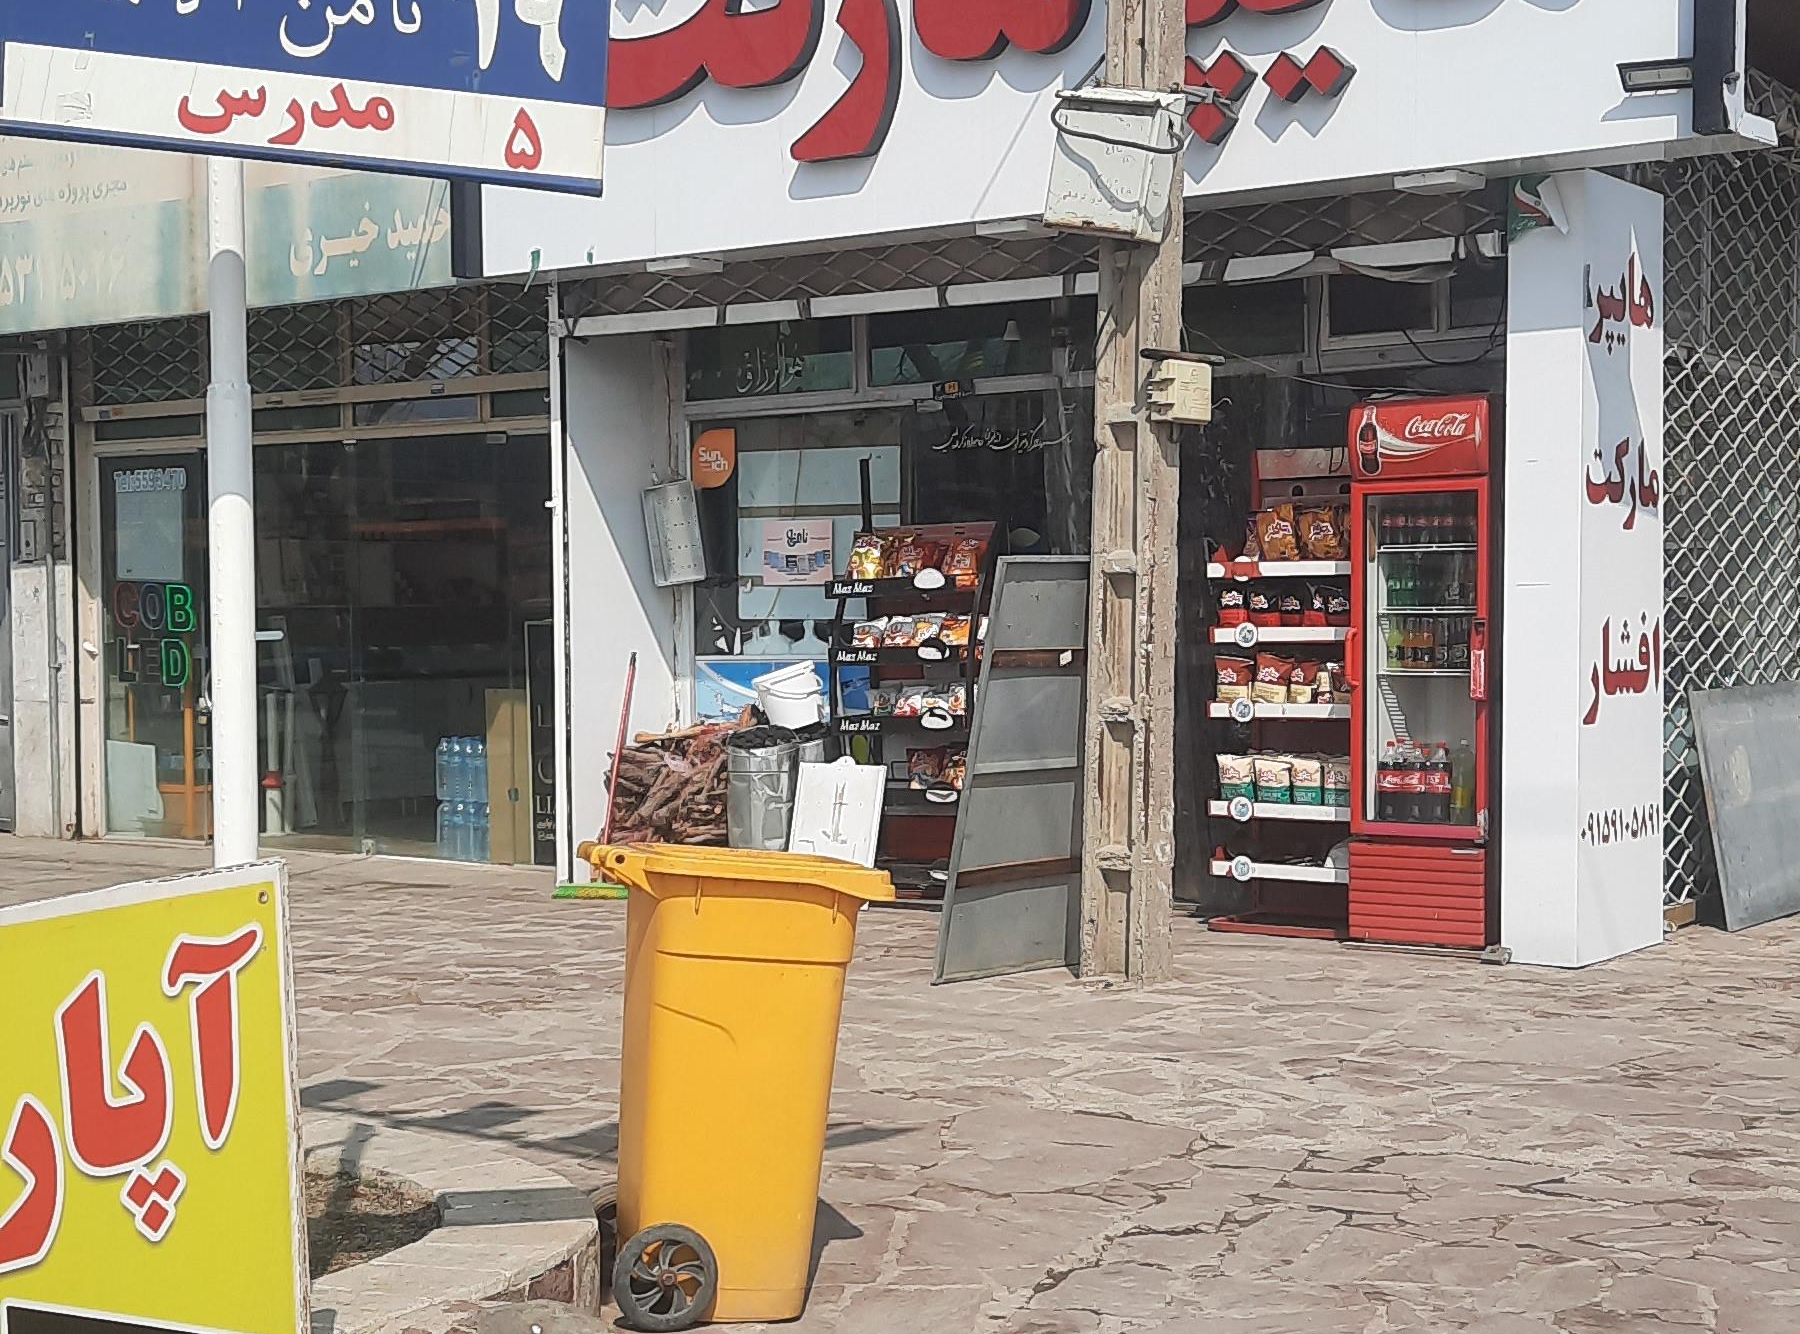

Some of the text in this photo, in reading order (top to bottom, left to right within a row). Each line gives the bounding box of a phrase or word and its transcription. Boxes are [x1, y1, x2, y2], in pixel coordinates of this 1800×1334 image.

[177, 82, 542, 170] ۵ مدرس
[289, 200, 379, 277] خیری
[1588, 251, 1654, 356] هایپر
[1585, 436, 1660, 531] مارکت
[113, 581, 197, 633] COB
[1582, 611, 1660, 726] افشار
[1580, 802, 1661, 847] ۰۹۱۵۹۱۰۵۸۹۱
